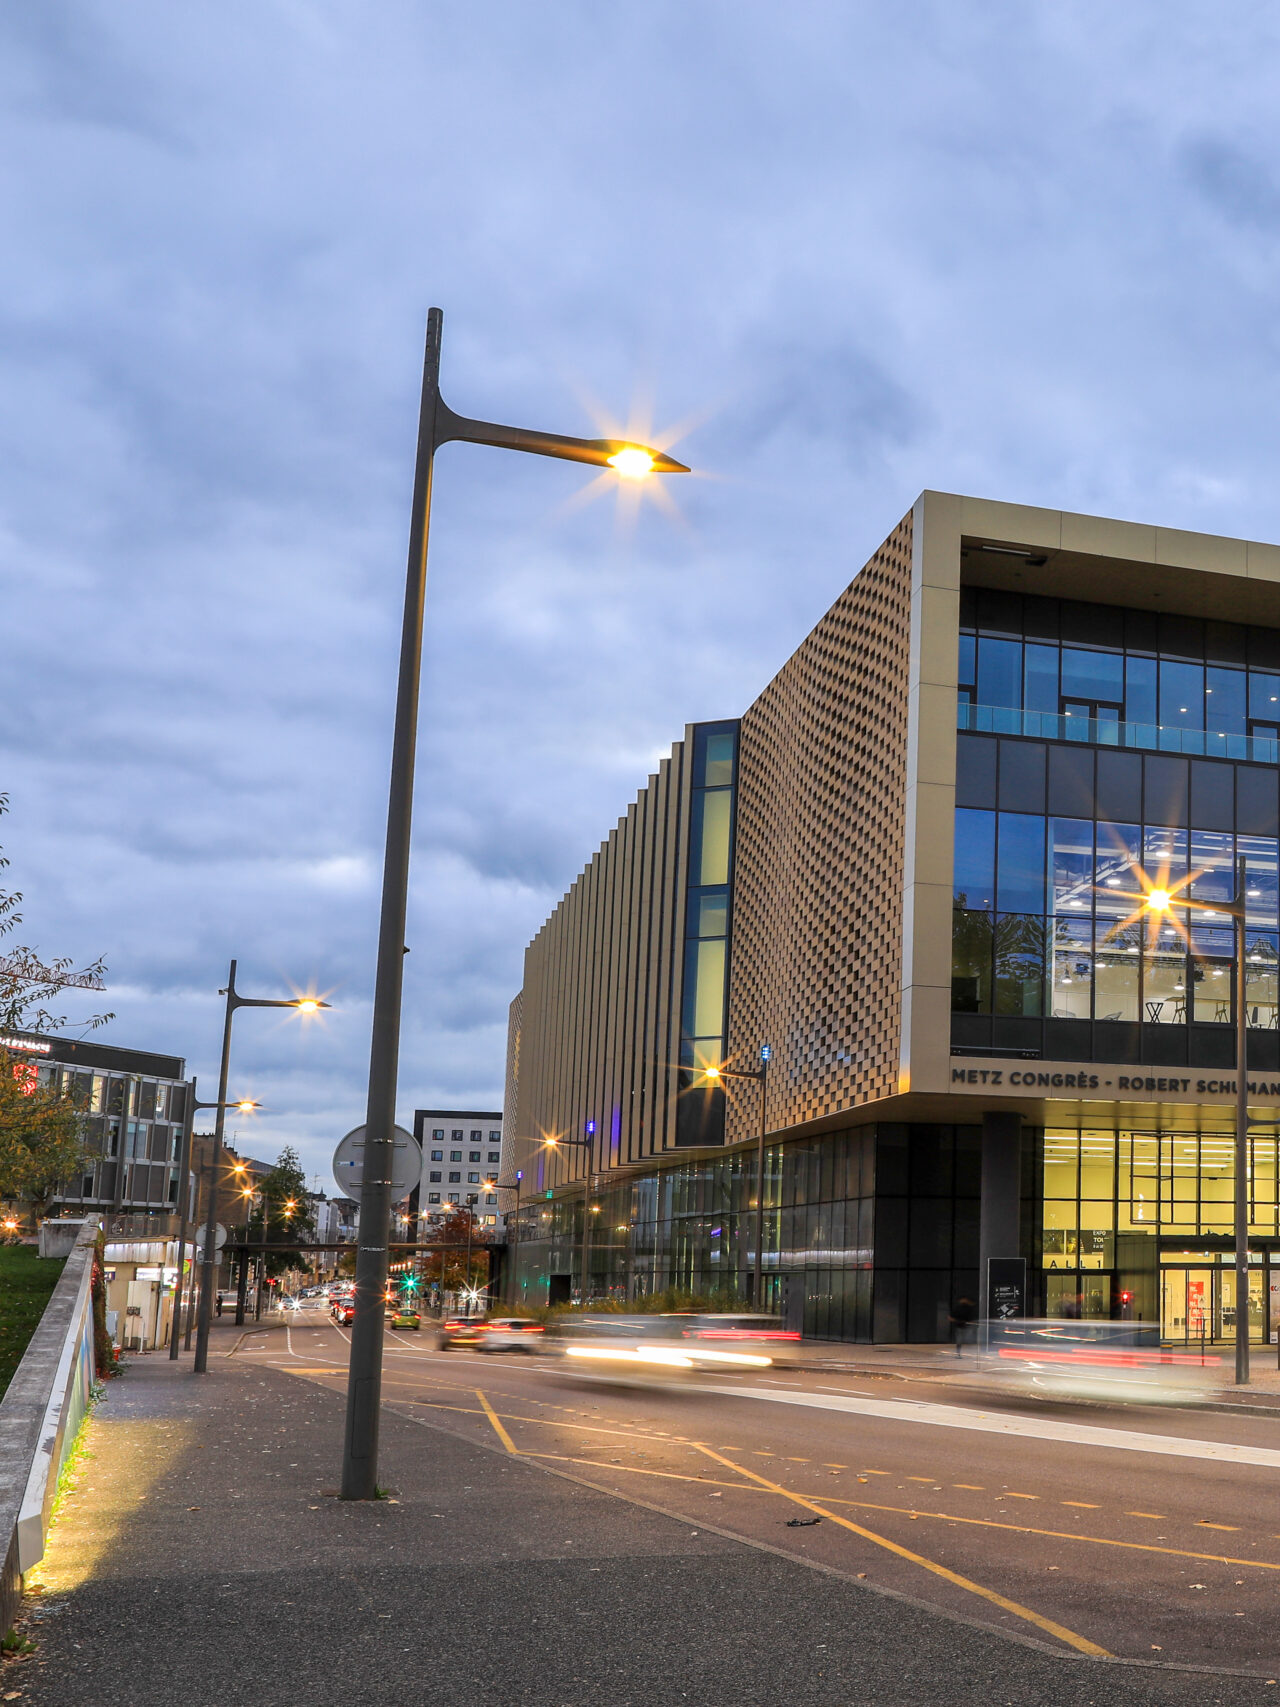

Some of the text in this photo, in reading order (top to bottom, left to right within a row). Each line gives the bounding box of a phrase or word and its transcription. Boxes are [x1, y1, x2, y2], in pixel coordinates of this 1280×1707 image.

[951, 1068, 1002, 1086] METZ
[1010, 1071, 1099, 1089] CONGRÈS
[1119, 1076, 1190, 1093] ROBERT
